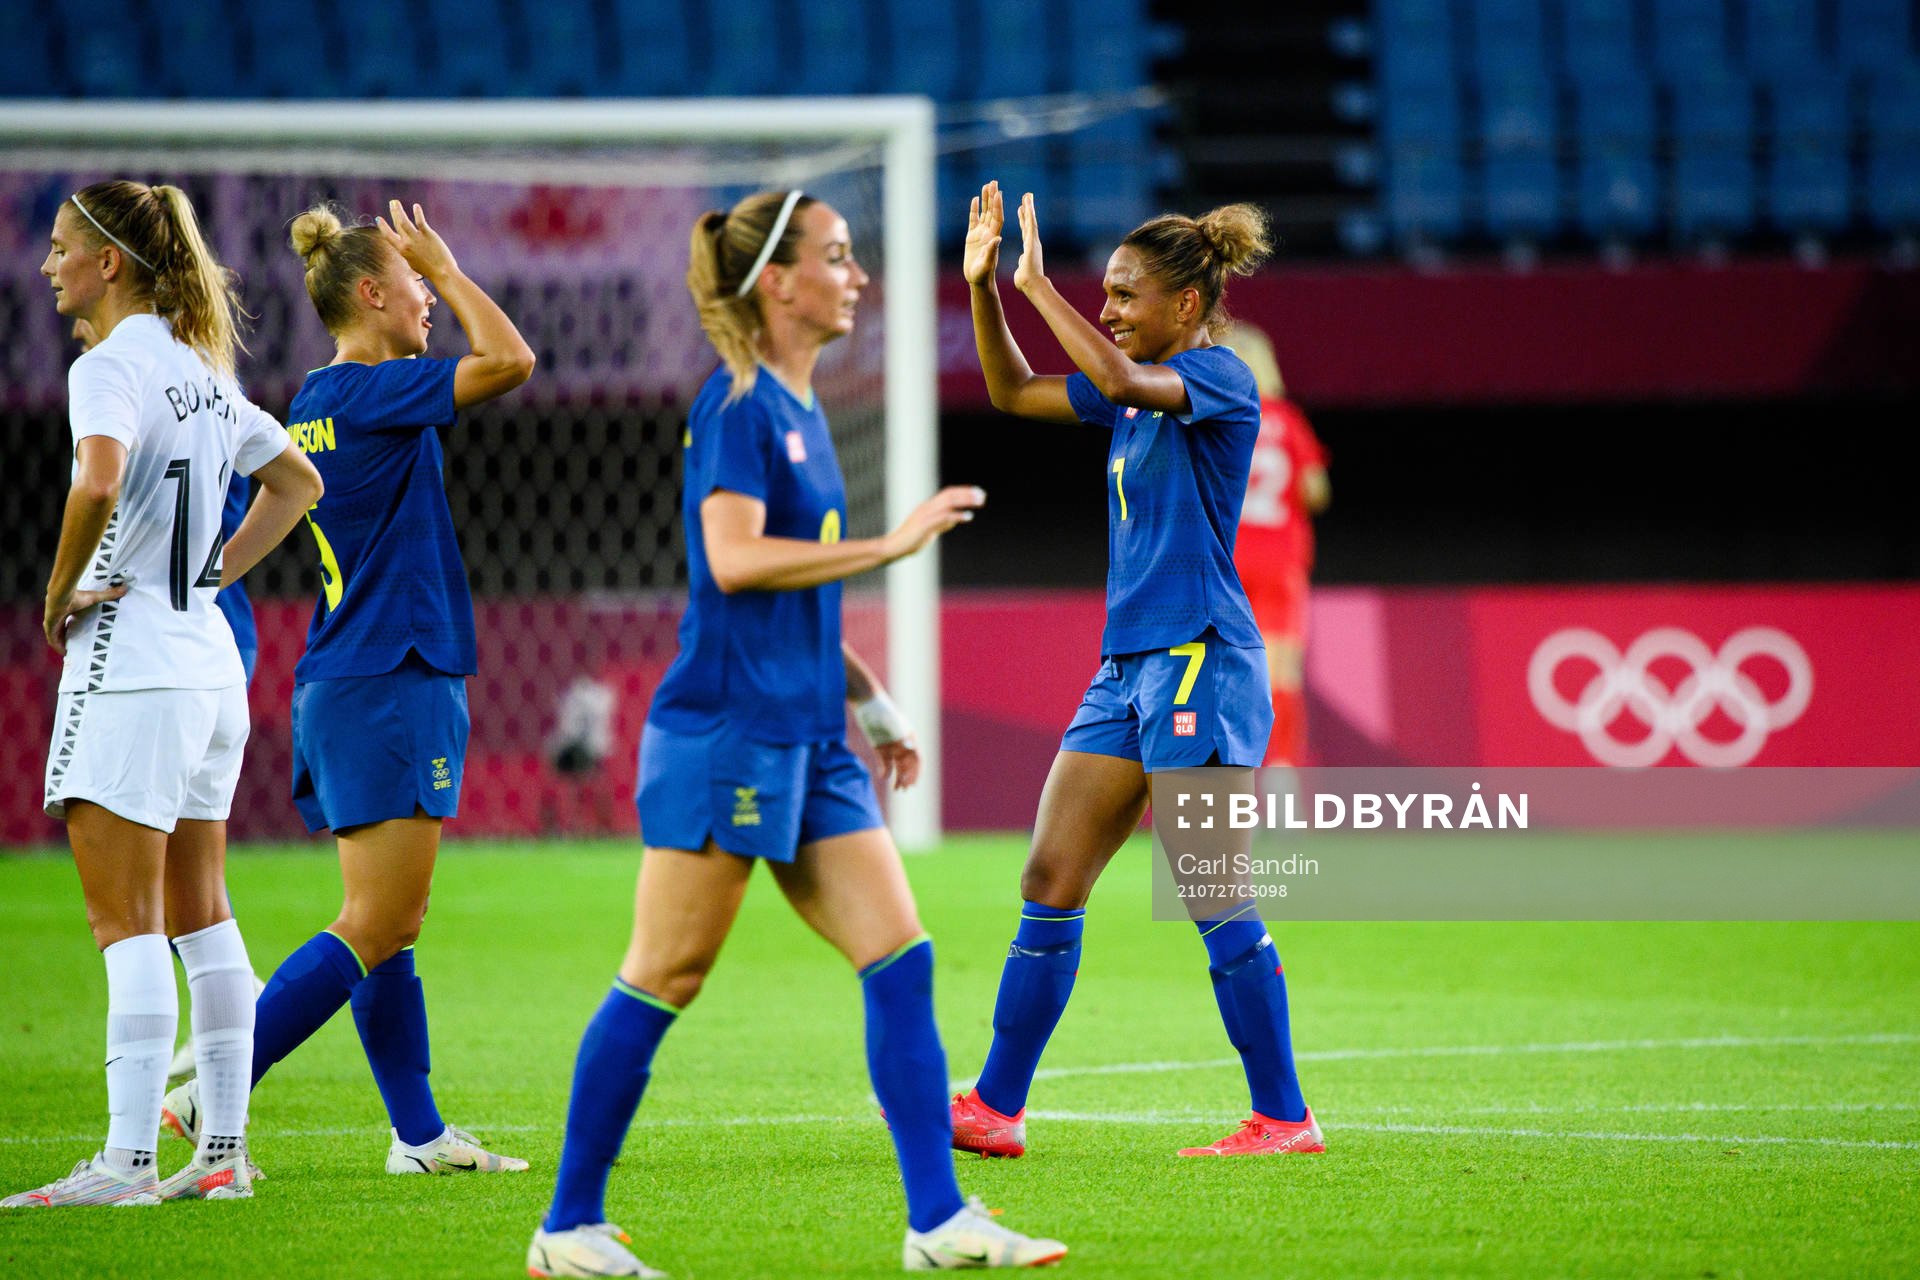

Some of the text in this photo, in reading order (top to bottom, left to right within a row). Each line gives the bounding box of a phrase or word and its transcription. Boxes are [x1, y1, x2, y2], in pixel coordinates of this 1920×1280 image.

[1169, 642, 1206, 705] 7
[1175, 714, 1193, 724] UNI
[1175, 724, 1194, 734] QLO
[433, 779, 452, 791] SWE
